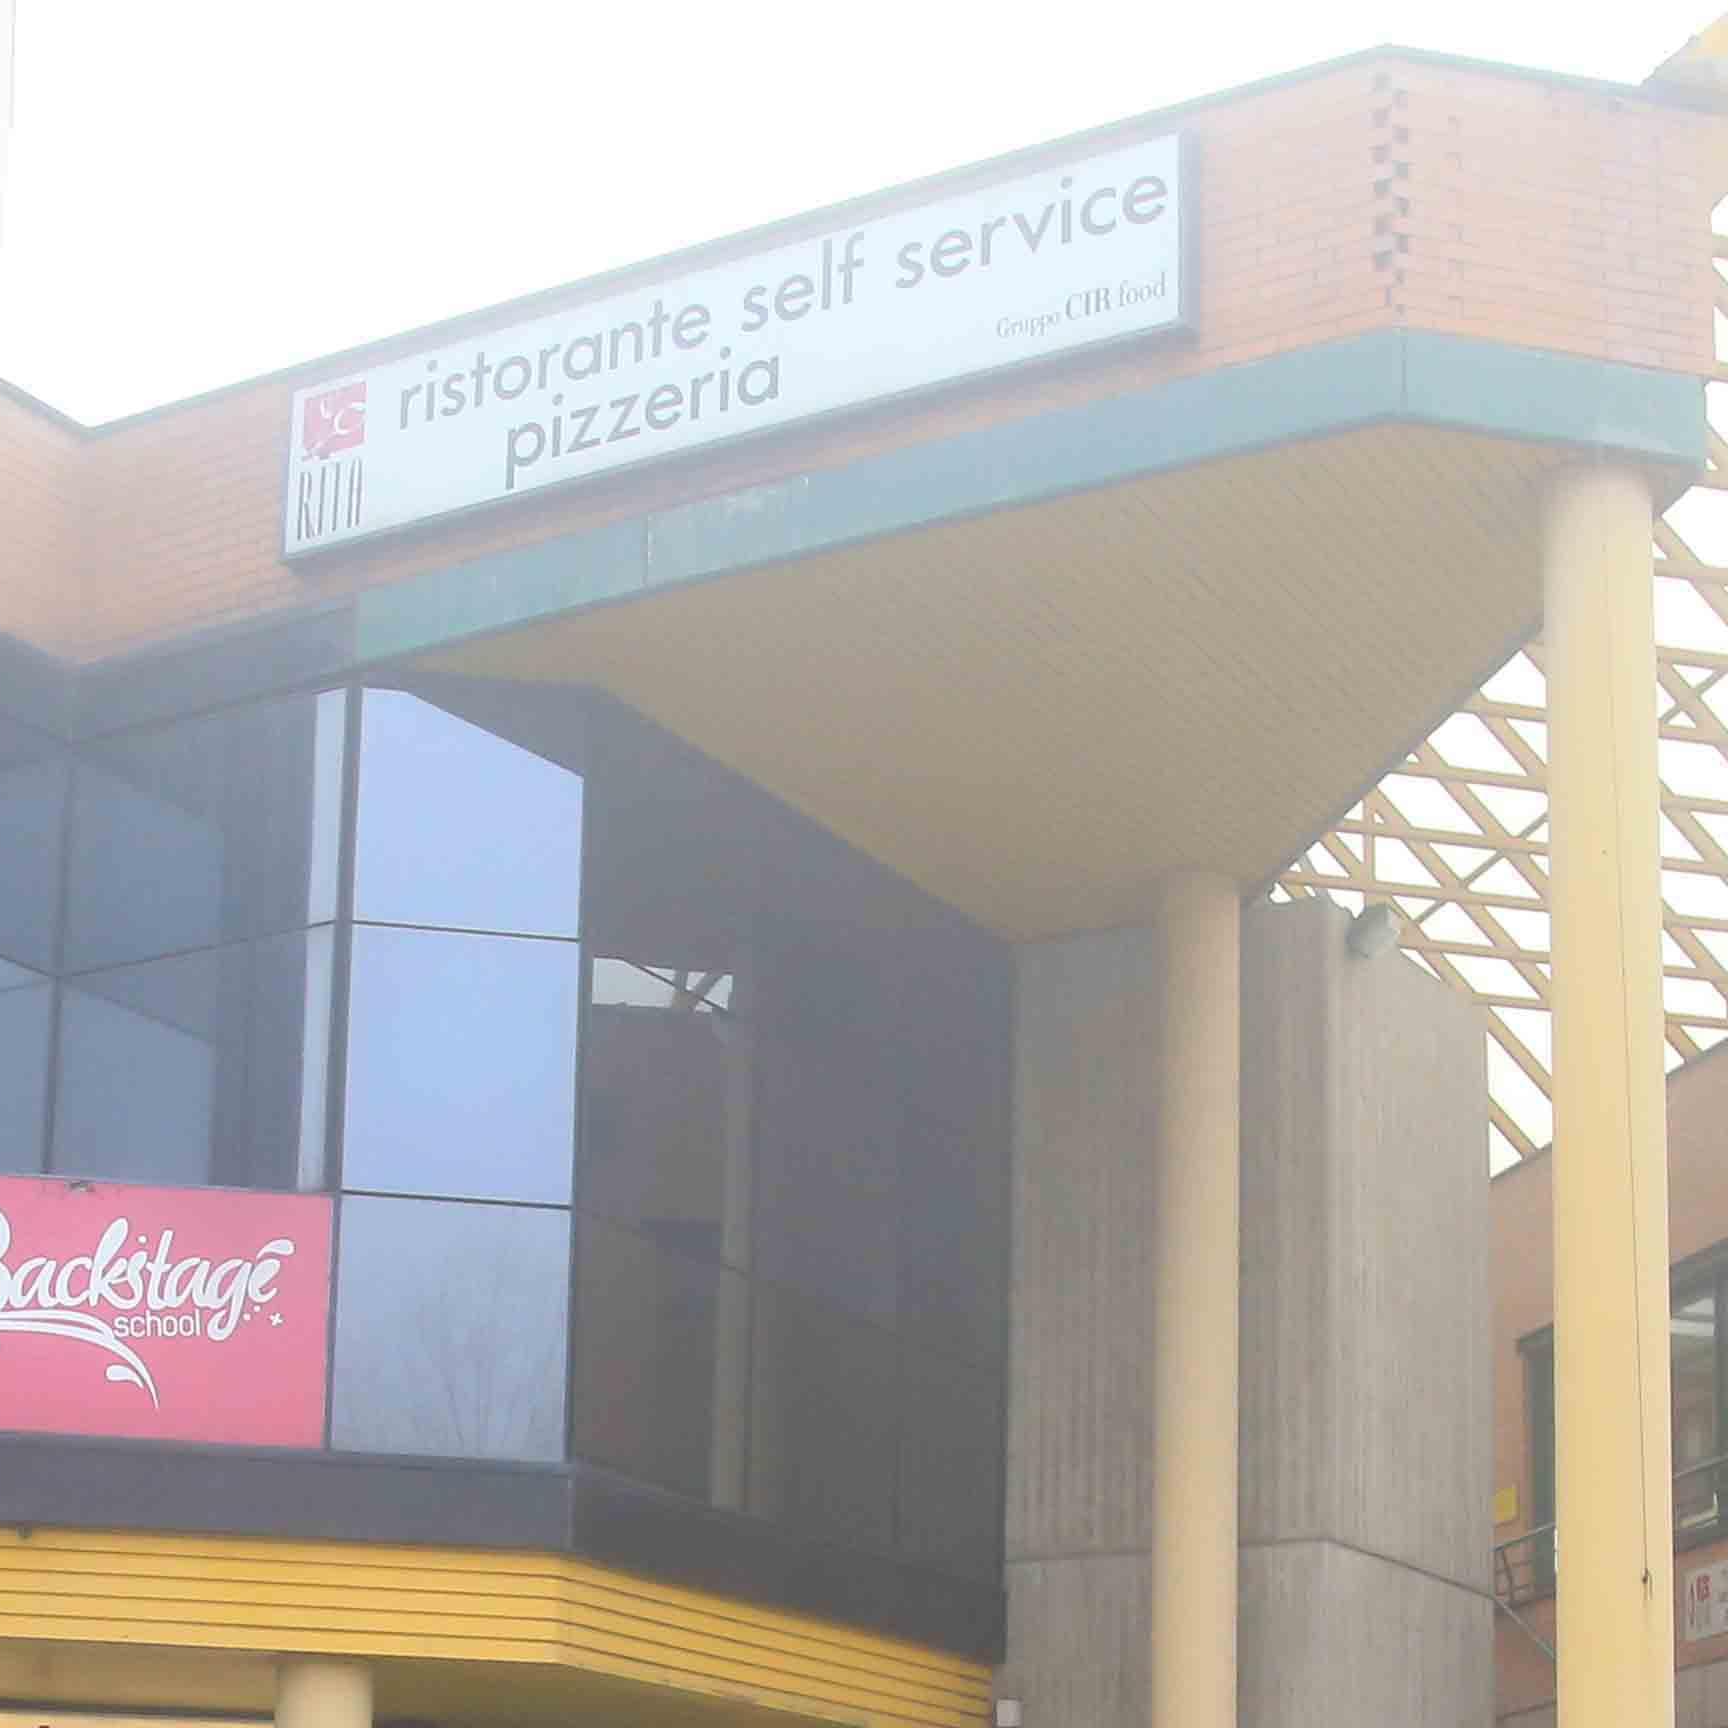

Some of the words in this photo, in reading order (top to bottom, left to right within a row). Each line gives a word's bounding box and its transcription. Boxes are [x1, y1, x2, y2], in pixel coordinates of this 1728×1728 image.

[400, 298, 712, 430] ristorante
[740, 231, 865, 333] self
[895, 175, 1169, 289] service
[996, 311, 1061, 338] Gruppo
[1065, 287, 1112, 321] CIR
[1119, 271, 1167, 307] food
[504, 346, 780, 490] pizzeria
[113, 1308, 201, 1338] school
